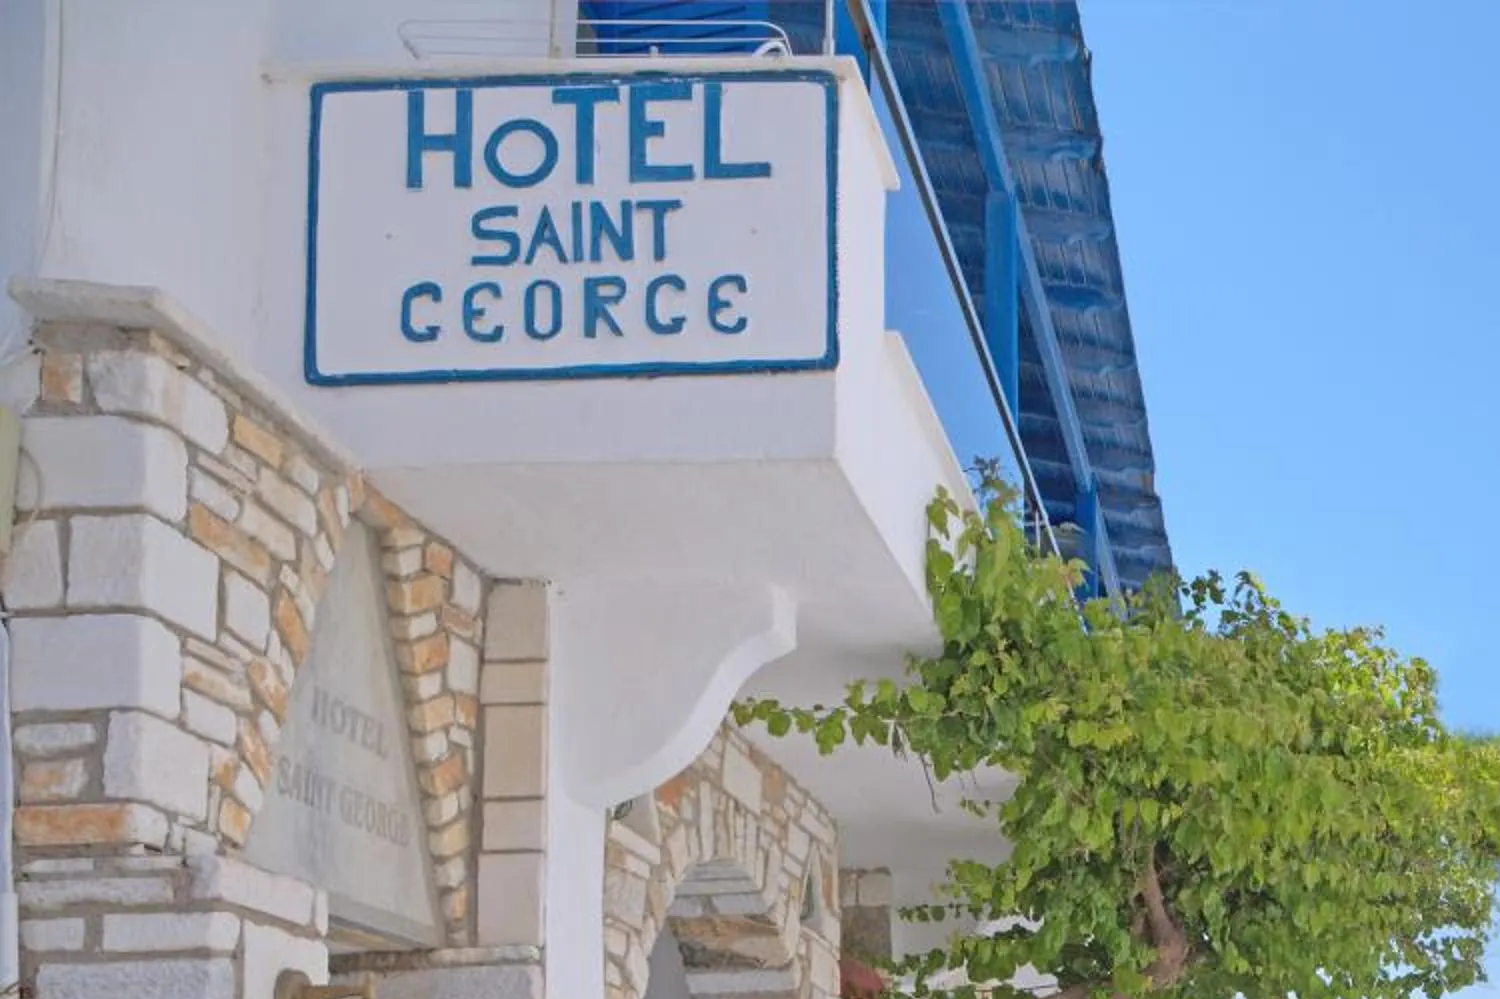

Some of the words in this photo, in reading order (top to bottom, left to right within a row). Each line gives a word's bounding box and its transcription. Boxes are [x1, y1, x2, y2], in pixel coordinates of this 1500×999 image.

[406, 83, 771, 188] HOTEL
[470, 200, 683, 266] SAINT
[401, 274, 748, 343] GEORGE
[311, 686, 389, 759] HOTEL
[277, 755, 336, 815] SAINT
